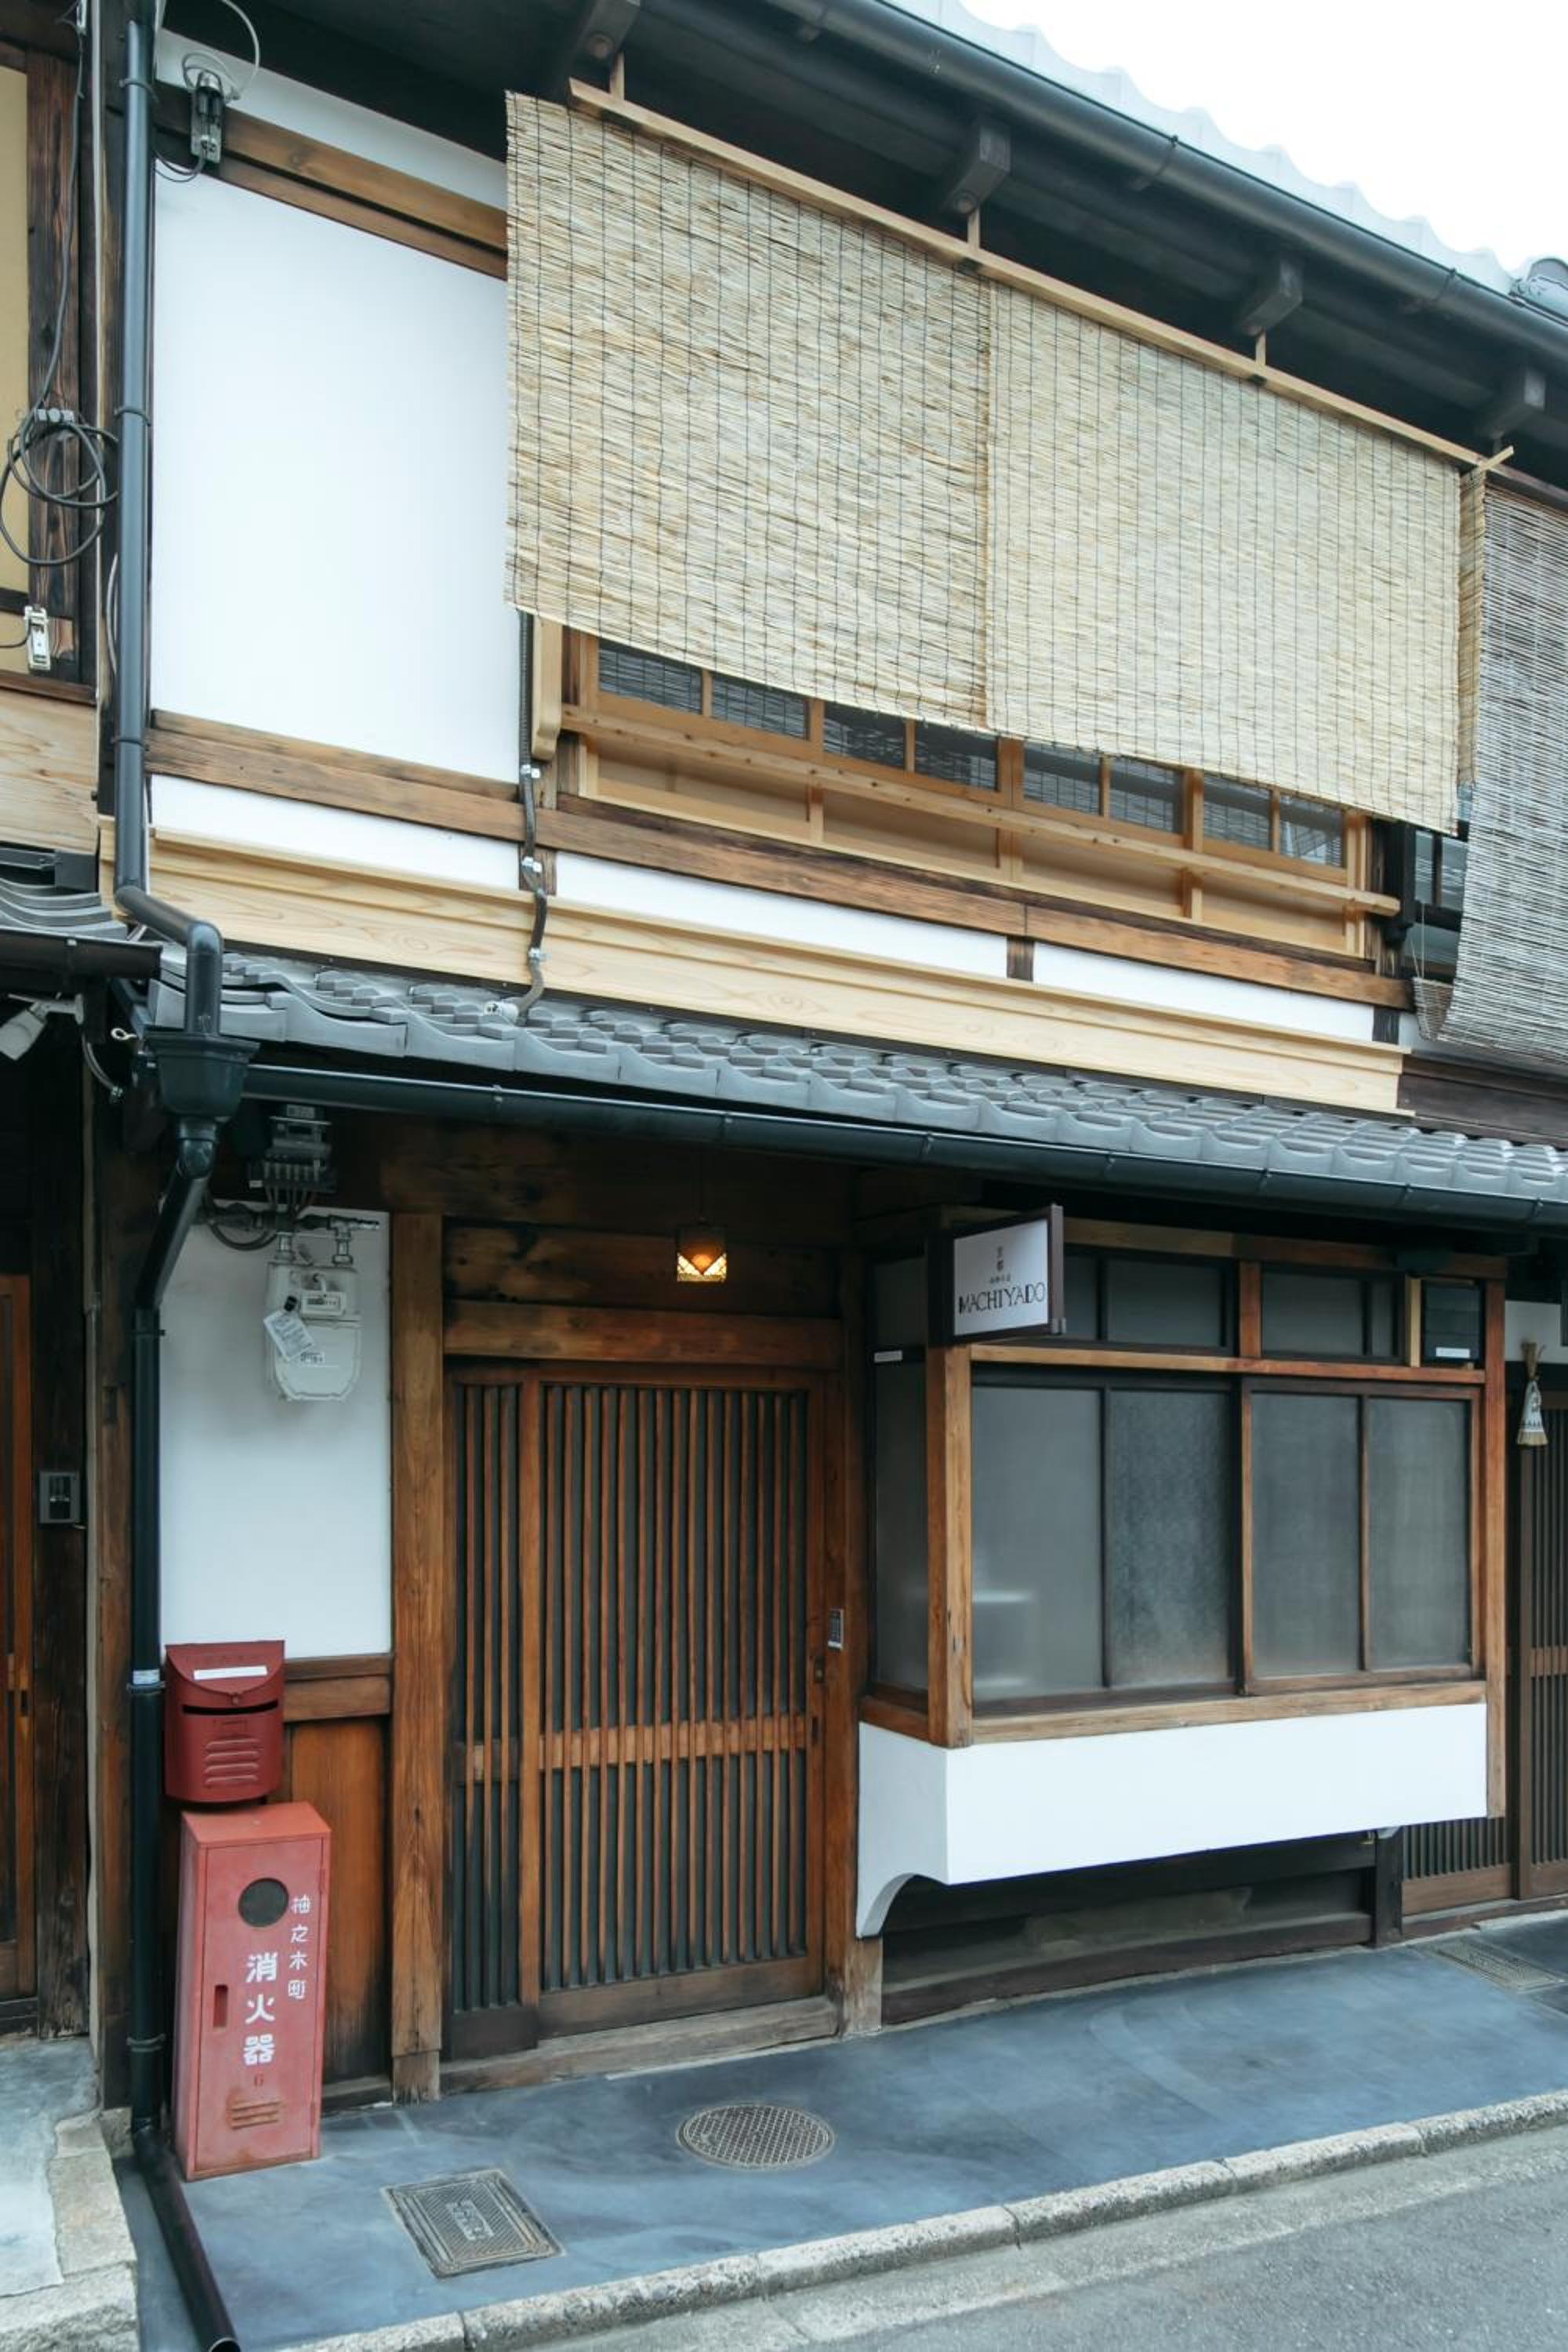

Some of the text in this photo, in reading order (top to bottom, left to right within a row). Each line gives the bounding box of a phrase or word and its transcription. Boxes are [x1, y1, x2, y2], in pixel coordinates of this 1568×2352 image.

[959, 1282, 1046, 1314] MACHIYADO
[243, 1951, 278, 2066] 消火器
